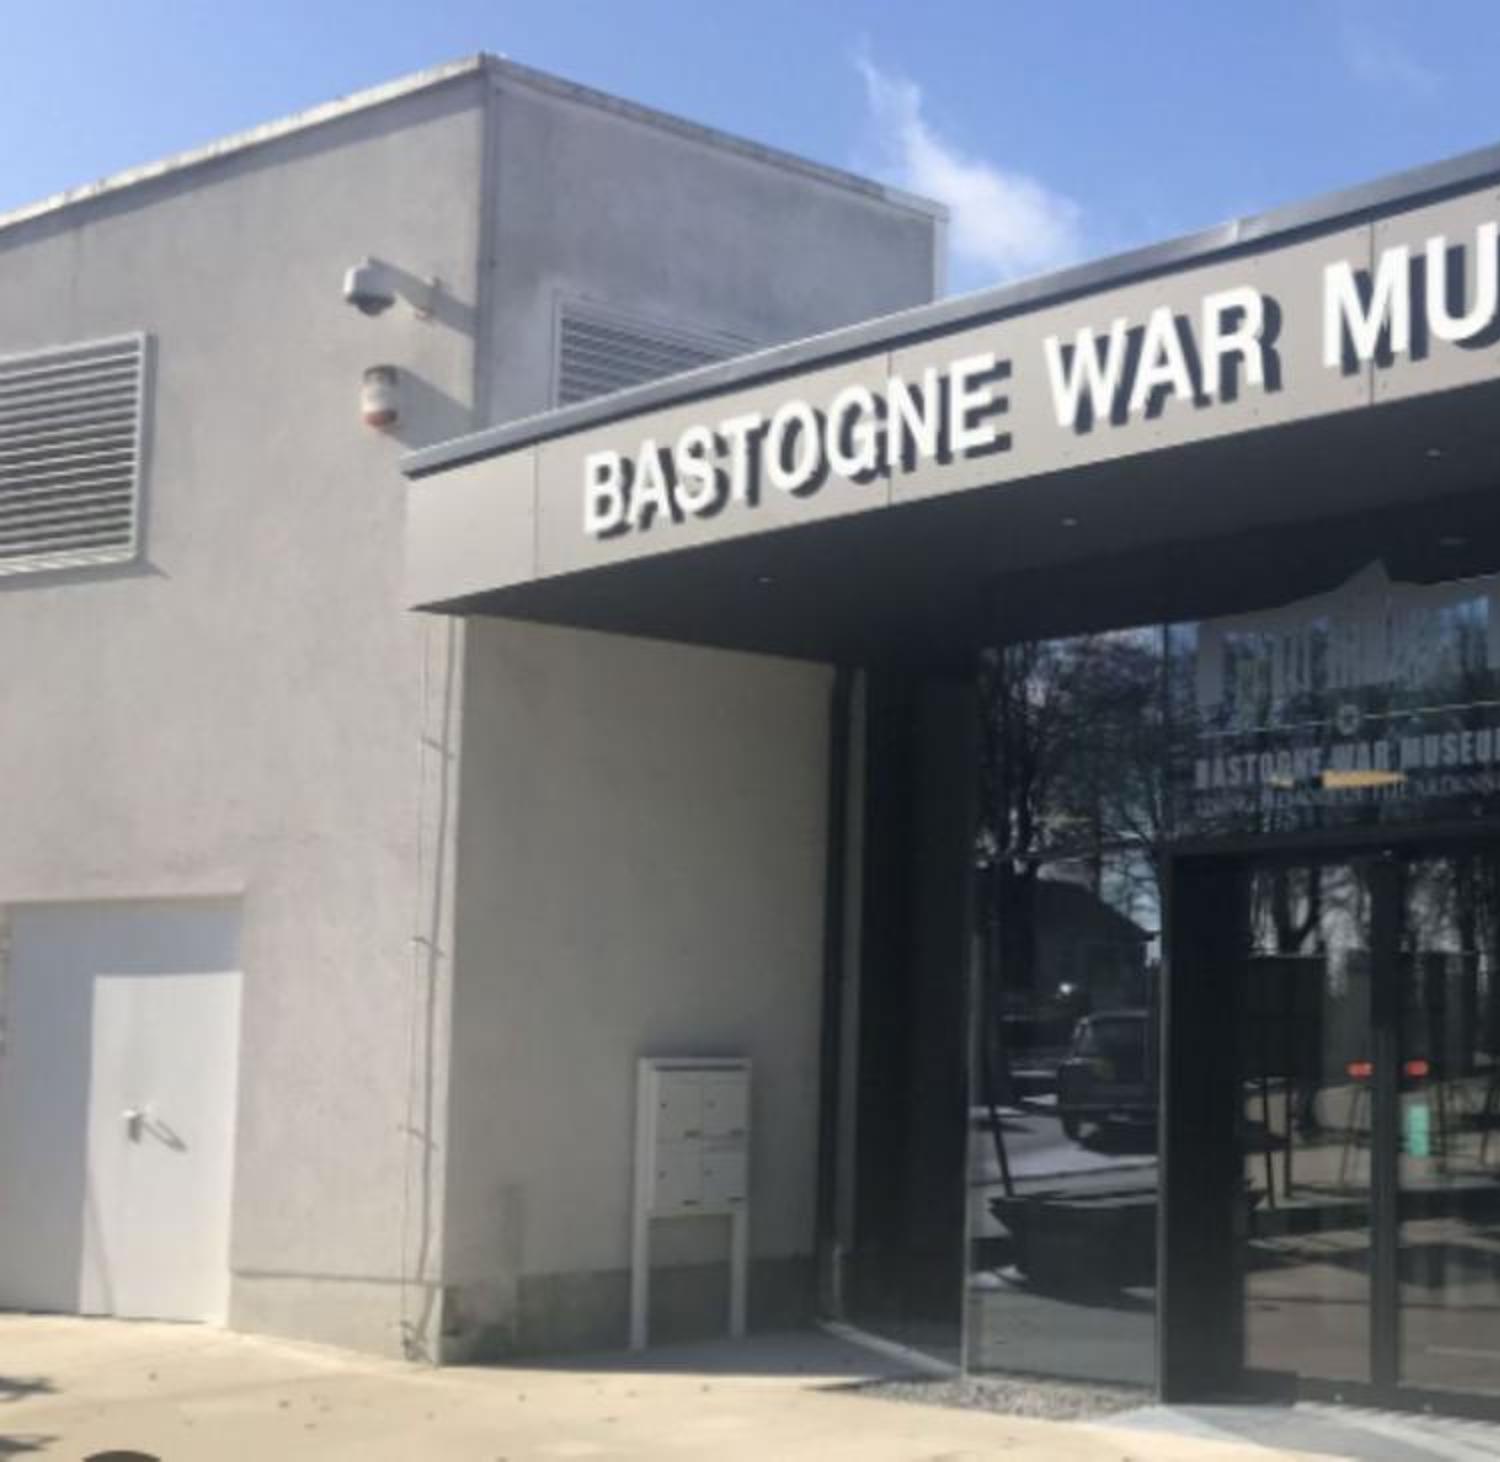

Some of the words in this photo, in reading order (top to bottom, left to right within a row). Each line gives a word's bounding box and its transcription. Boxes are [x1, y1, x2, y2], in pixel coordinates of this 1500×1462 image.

[584, 352, 997, 534] BASTOGNE
[1044, 284, 1266, 428] WAR
[1195, 746, 1322, 789] BASTOGNE
[1331, 737, 1390, 772] WAR
